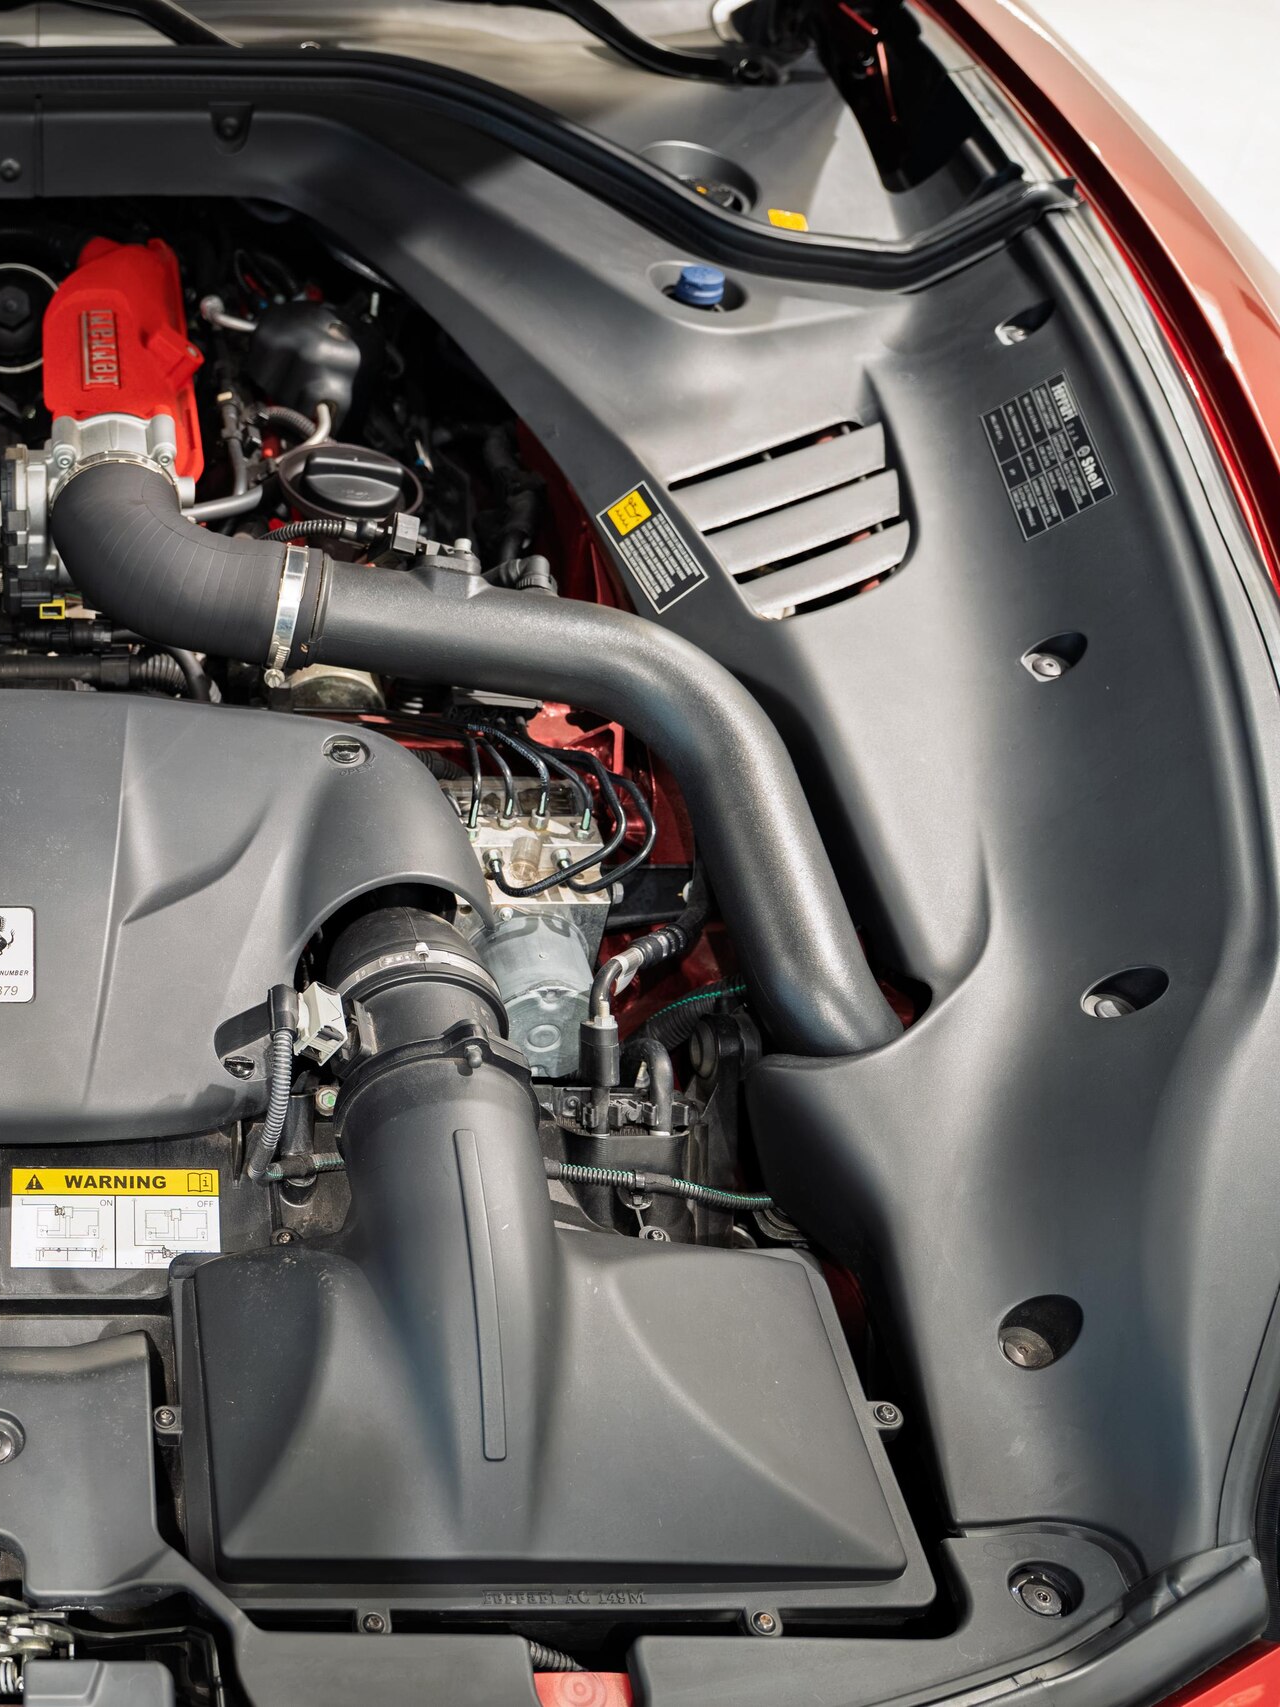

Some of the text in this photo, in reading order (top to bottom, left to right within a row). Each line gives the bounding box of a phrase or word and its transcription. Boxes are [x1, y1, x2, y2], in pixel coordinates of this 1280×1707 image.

[81, 310, 118, 386] Ferrari
[1081, 456, 1104, 490] Shell
[64, 1175, 167, 1189] WARNING
[197, 1200, 214, 1208] OFF
